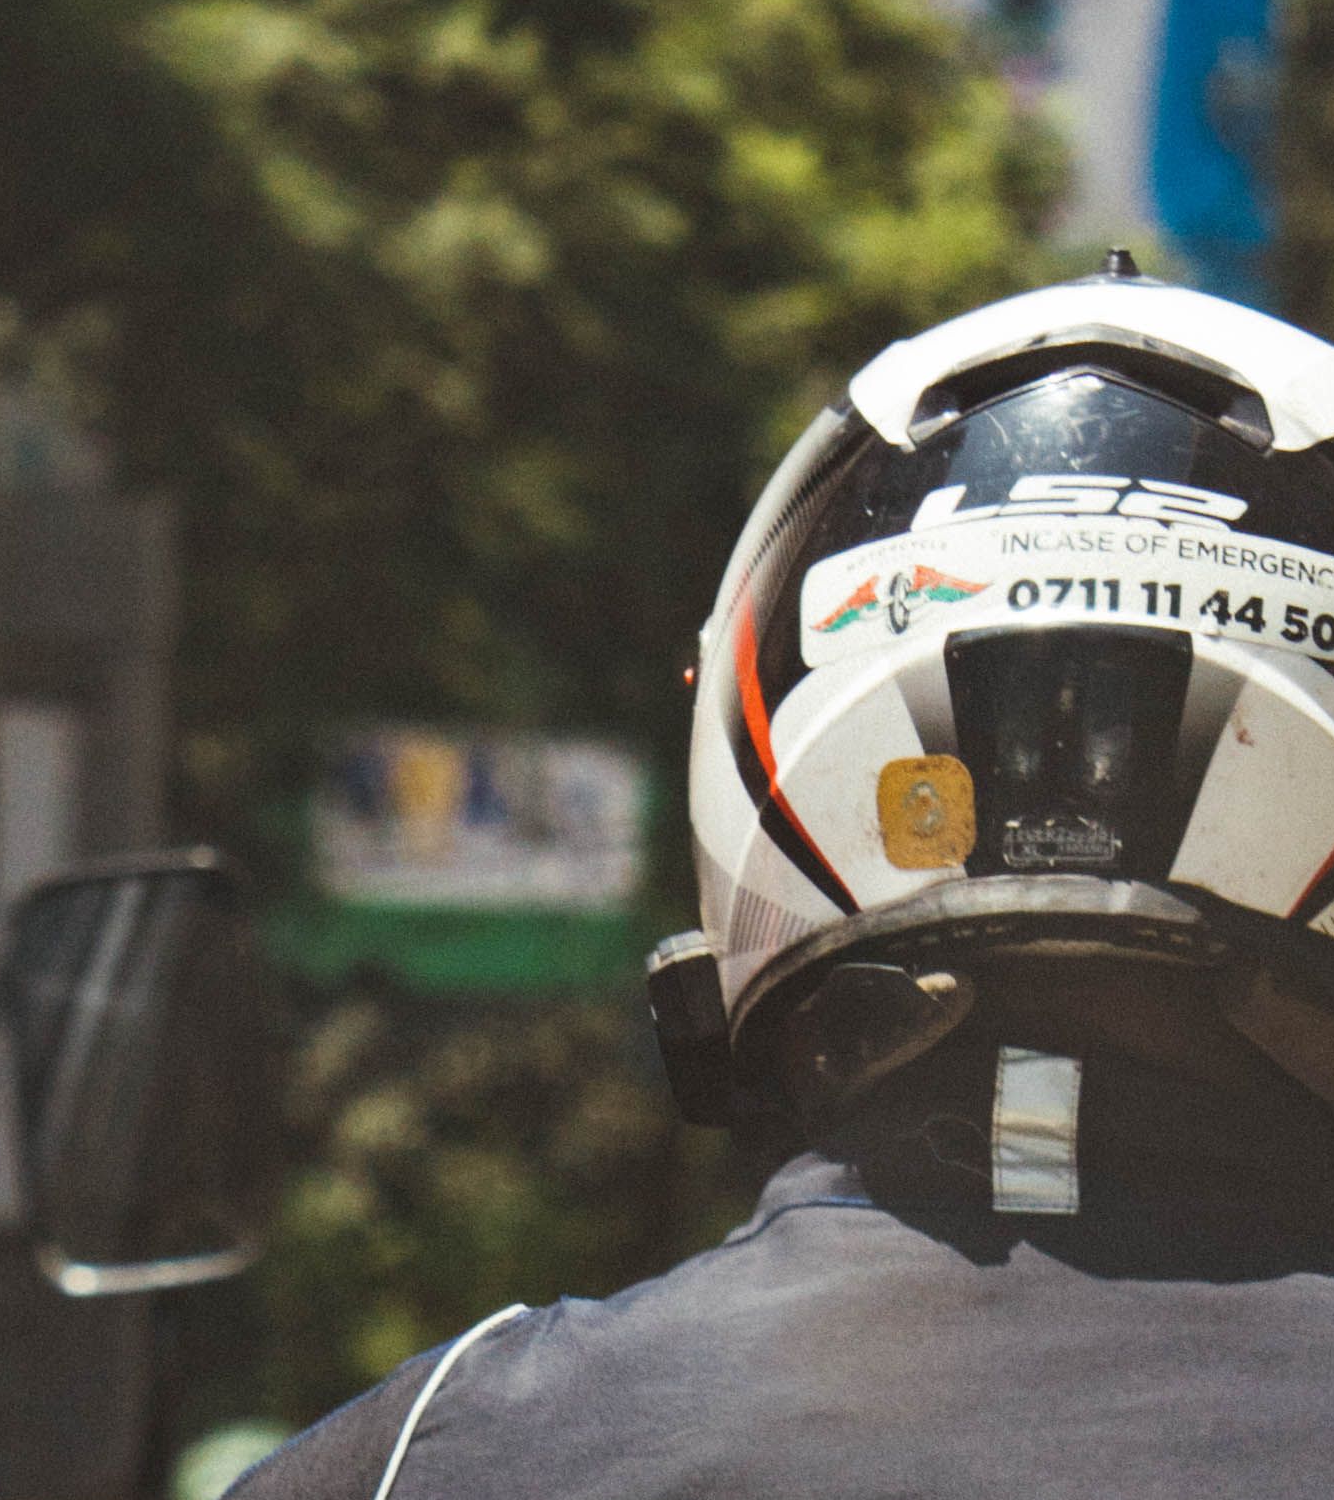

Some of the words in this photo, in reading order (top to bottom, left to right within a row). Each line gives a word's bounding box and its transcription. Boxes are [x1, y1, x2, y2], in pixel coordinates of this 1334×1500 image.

[910, 474, 1248, 532] LS2
[1001, 530, 1115, 554] INCASE
[1124, 534, 1168, 556] OF
[1006, 577, 1121, 613] 0711
[1140, 581, 1183, 619] 11
[1199, 590, 1267, 634] 44
